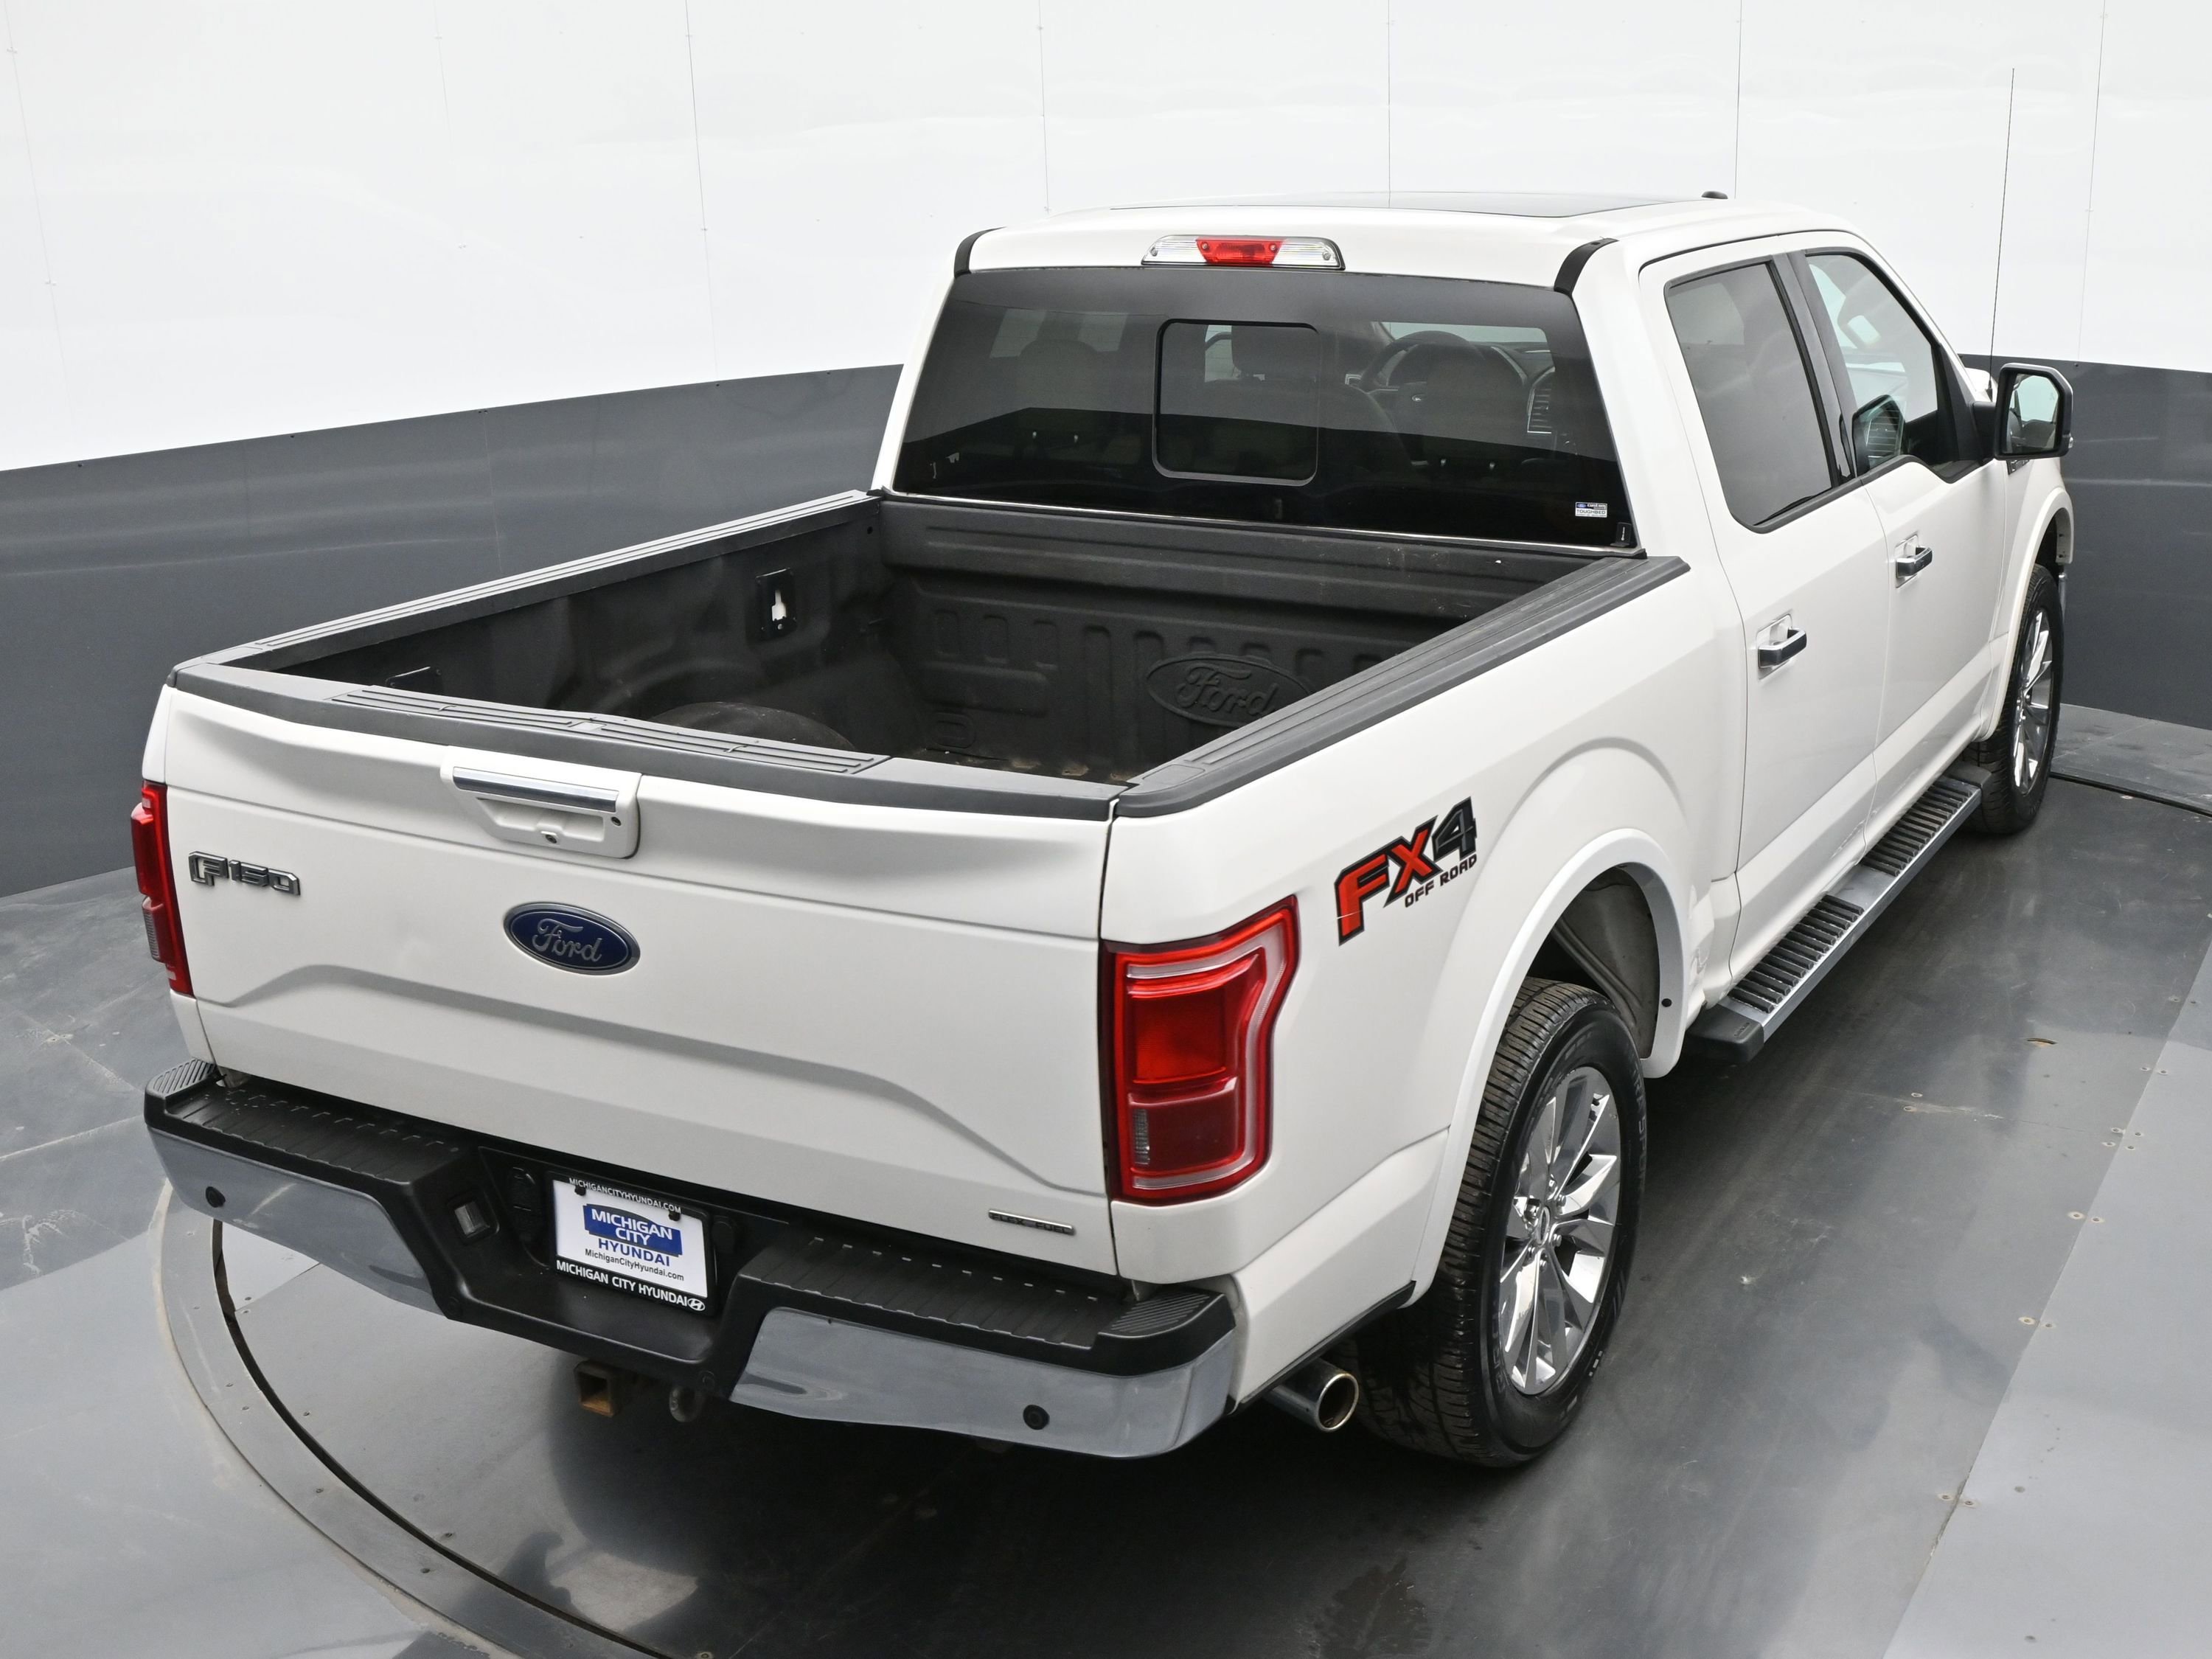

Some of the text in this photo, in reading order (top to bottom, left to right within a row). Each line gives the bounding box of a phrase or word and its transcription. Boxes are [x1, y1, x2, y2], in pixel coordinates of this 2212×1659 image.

[1177, 662, 1279, 717] Ford
[1334, 796, 1477, 947] FX4
[1405, 854, 1477, 908] OFF ROAD
[532, 918, 602, 962] Ford
[569, 1178, 681, 1213] MICHIGANCITYHYUNDAI.COM
[591, 1208, 673, 1240] MICHIGAN
[615, 1228, 651, 1246] CITY
[585, 1248, 685, 1281] MichiganCityHyundai.com
[598, 1238, 671, 1267] HYUNDAI
[556, 1259, 688, 1307] MICHIGAN CITY HYUNDAI
